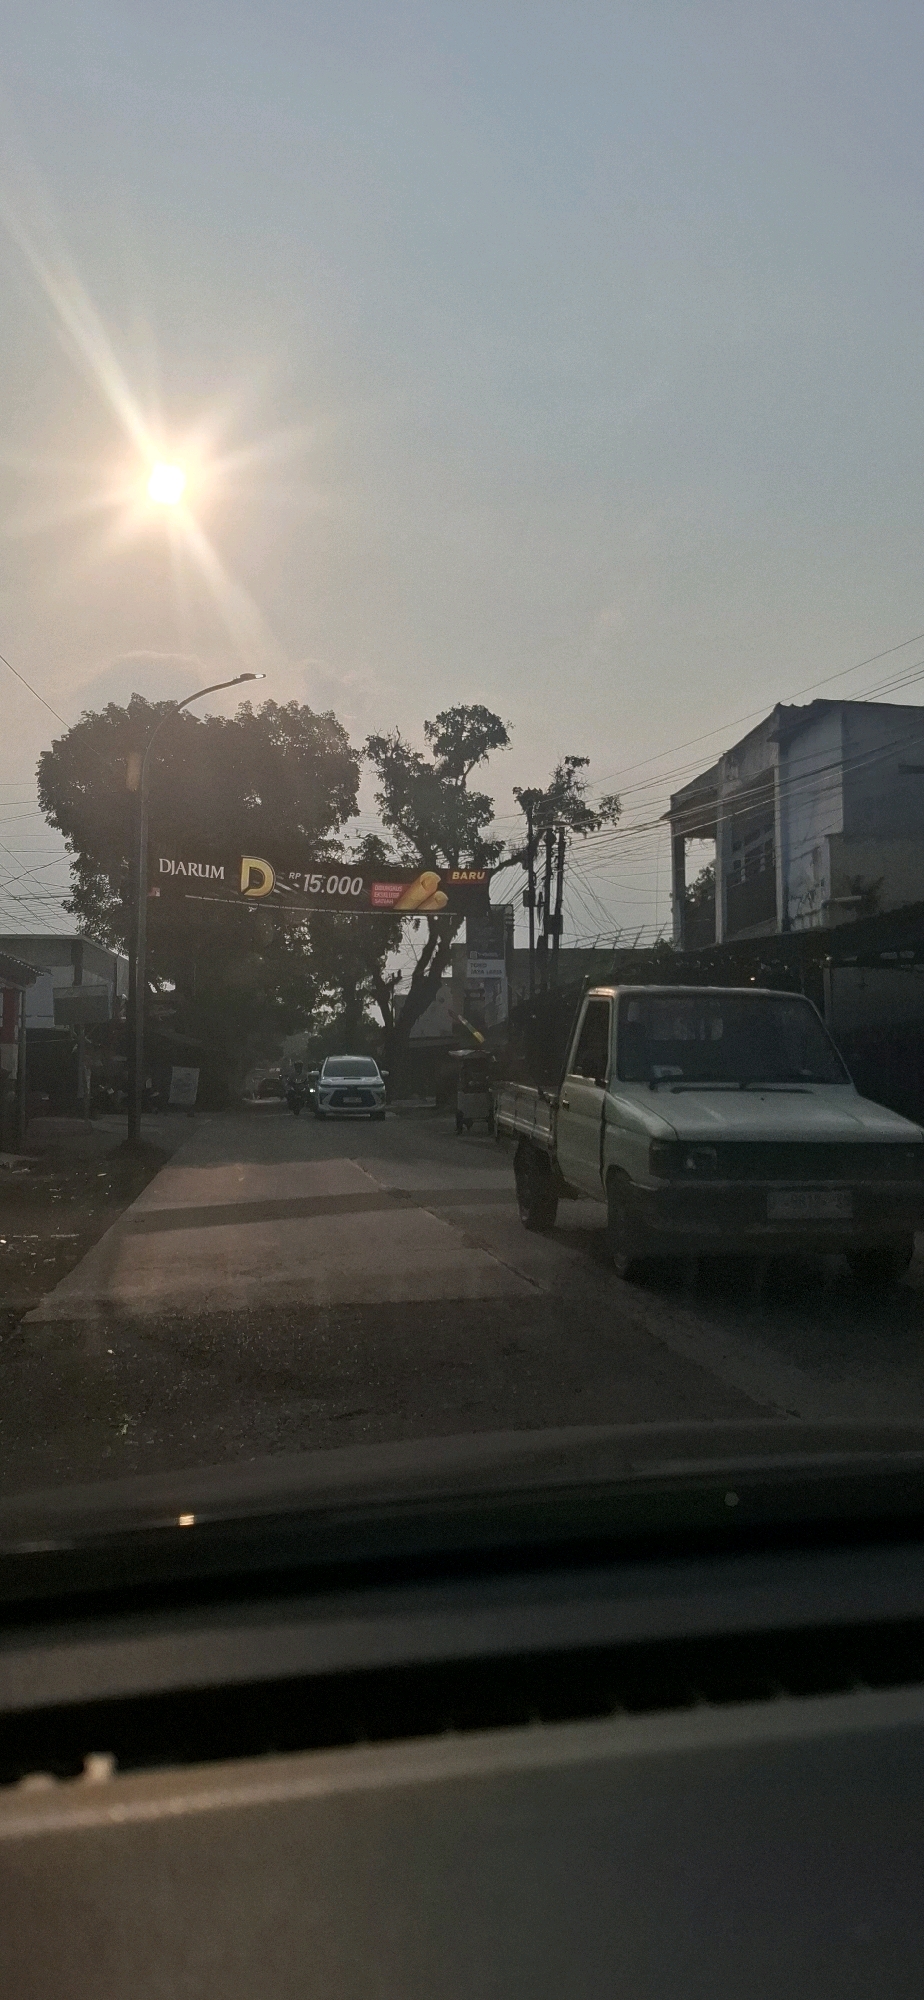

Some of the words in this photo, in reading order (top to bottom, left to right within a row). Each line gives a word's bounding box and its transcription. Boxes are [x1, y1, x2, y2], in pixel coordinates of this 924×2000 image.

[158, 858, 225, 880] DJARUM
[451, 871, 486, 880] BARU
[288, 872, 302, 880] RP
[303, 873, 364, 896] 15.000
